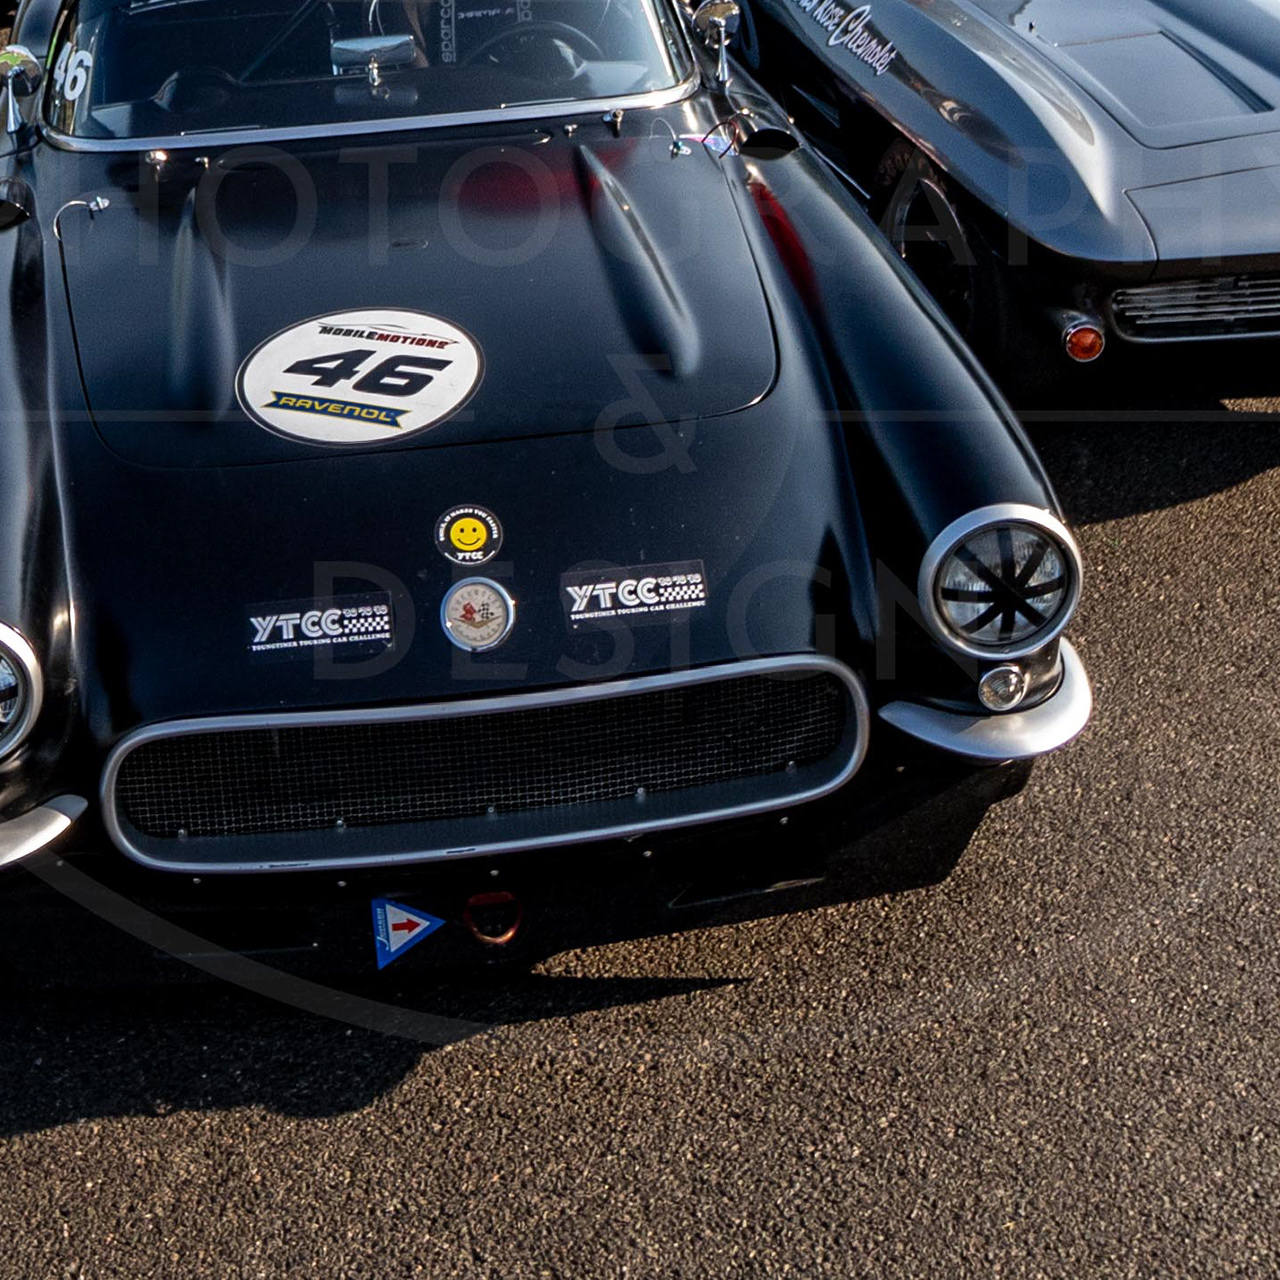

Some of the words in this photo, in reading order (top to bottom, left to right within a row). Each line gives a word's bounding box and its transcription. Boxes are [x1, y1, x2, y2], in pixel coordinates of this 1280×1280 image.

[828, 4, 898, 76] Chevrolet
[53, 41, 94, 101] 46
[318, 325, 451, 350] MOBILEMOTIONS
[282, 348, 454, 398] 46
[278, 396, 394, 423] RAVENOL
[456, 551, 484, 561] YTCC
[565, 577, 661, 613] YTCC
[616, 606, 649, 616] TOURING
[649, 604, 665, 613] CAR
[665, 600, 707, 610] CHALLENGE
[249, 609, 344, 644] YTCC
[299, 637, 332, 647] TOURING
[332, 636, 348, 644] CAR
[349, 632, 391, 642] CHALLENGE
